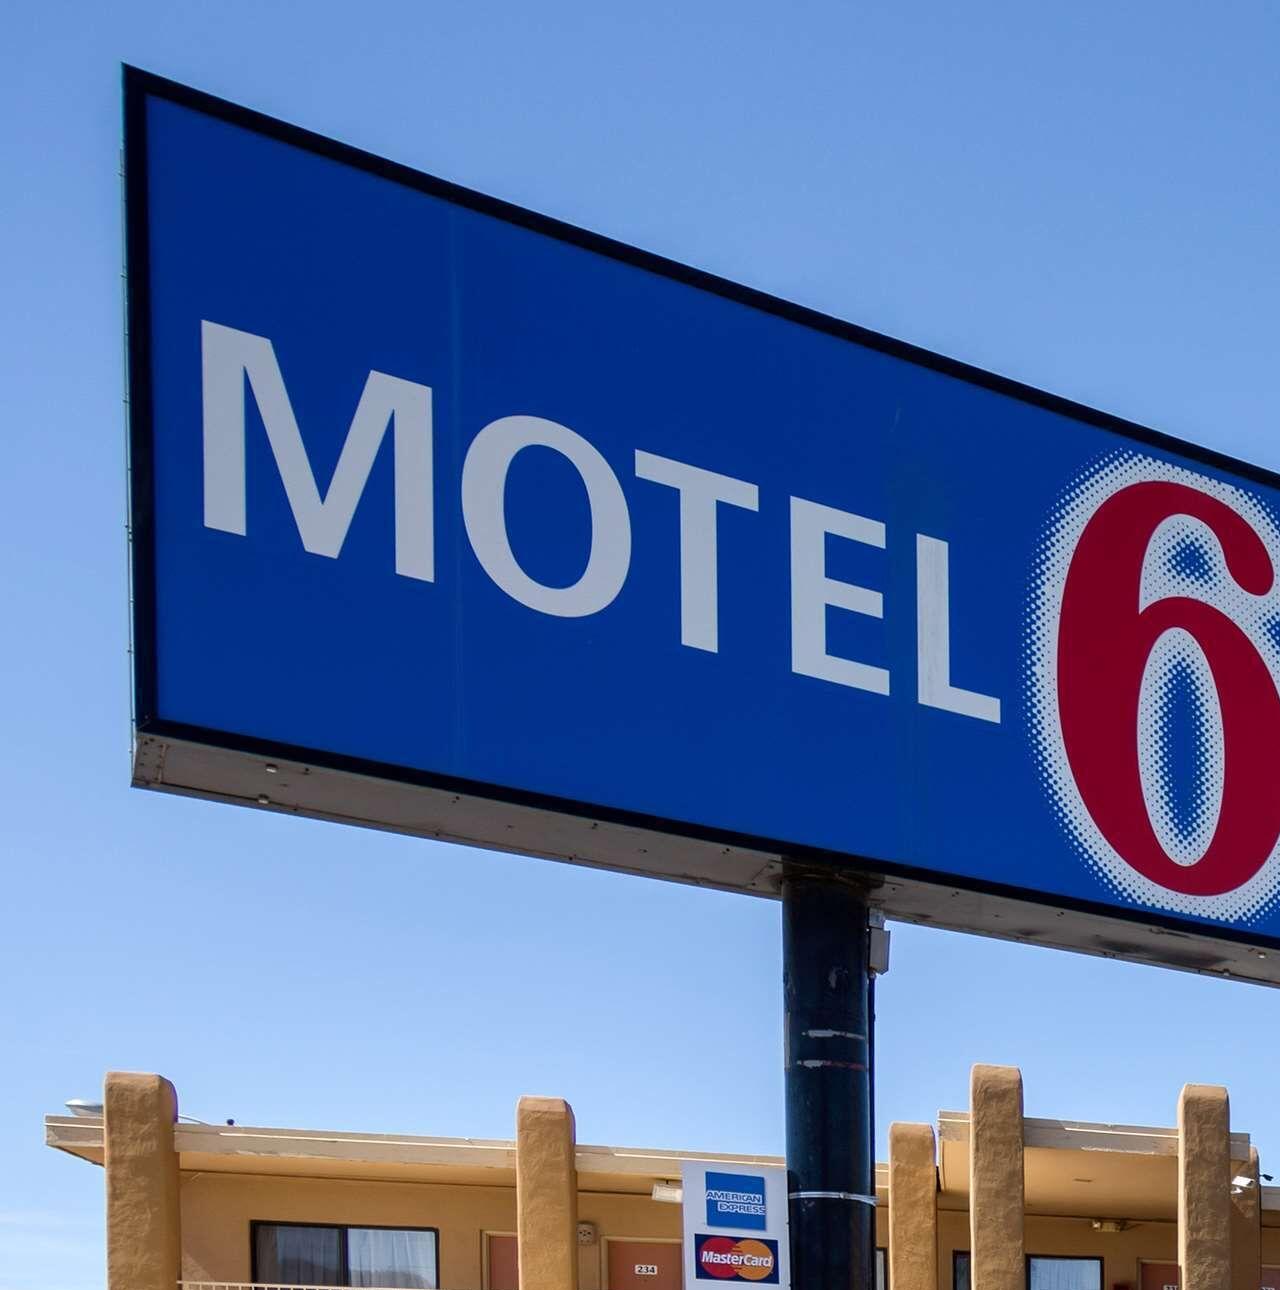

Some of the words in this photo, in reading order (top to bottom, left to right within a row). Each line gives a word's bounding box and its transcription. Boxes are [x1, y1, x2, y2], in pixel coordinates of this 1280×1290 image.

[202, 320, 1000, 723] MOTEL
[706, 1190, 762, 1204] AMERICAN
[718, 1202, 766, 1215] EXPRESS
[702, 1251, 772, 1267] MasterCard
[637, 1265, 656, 1274] 234
